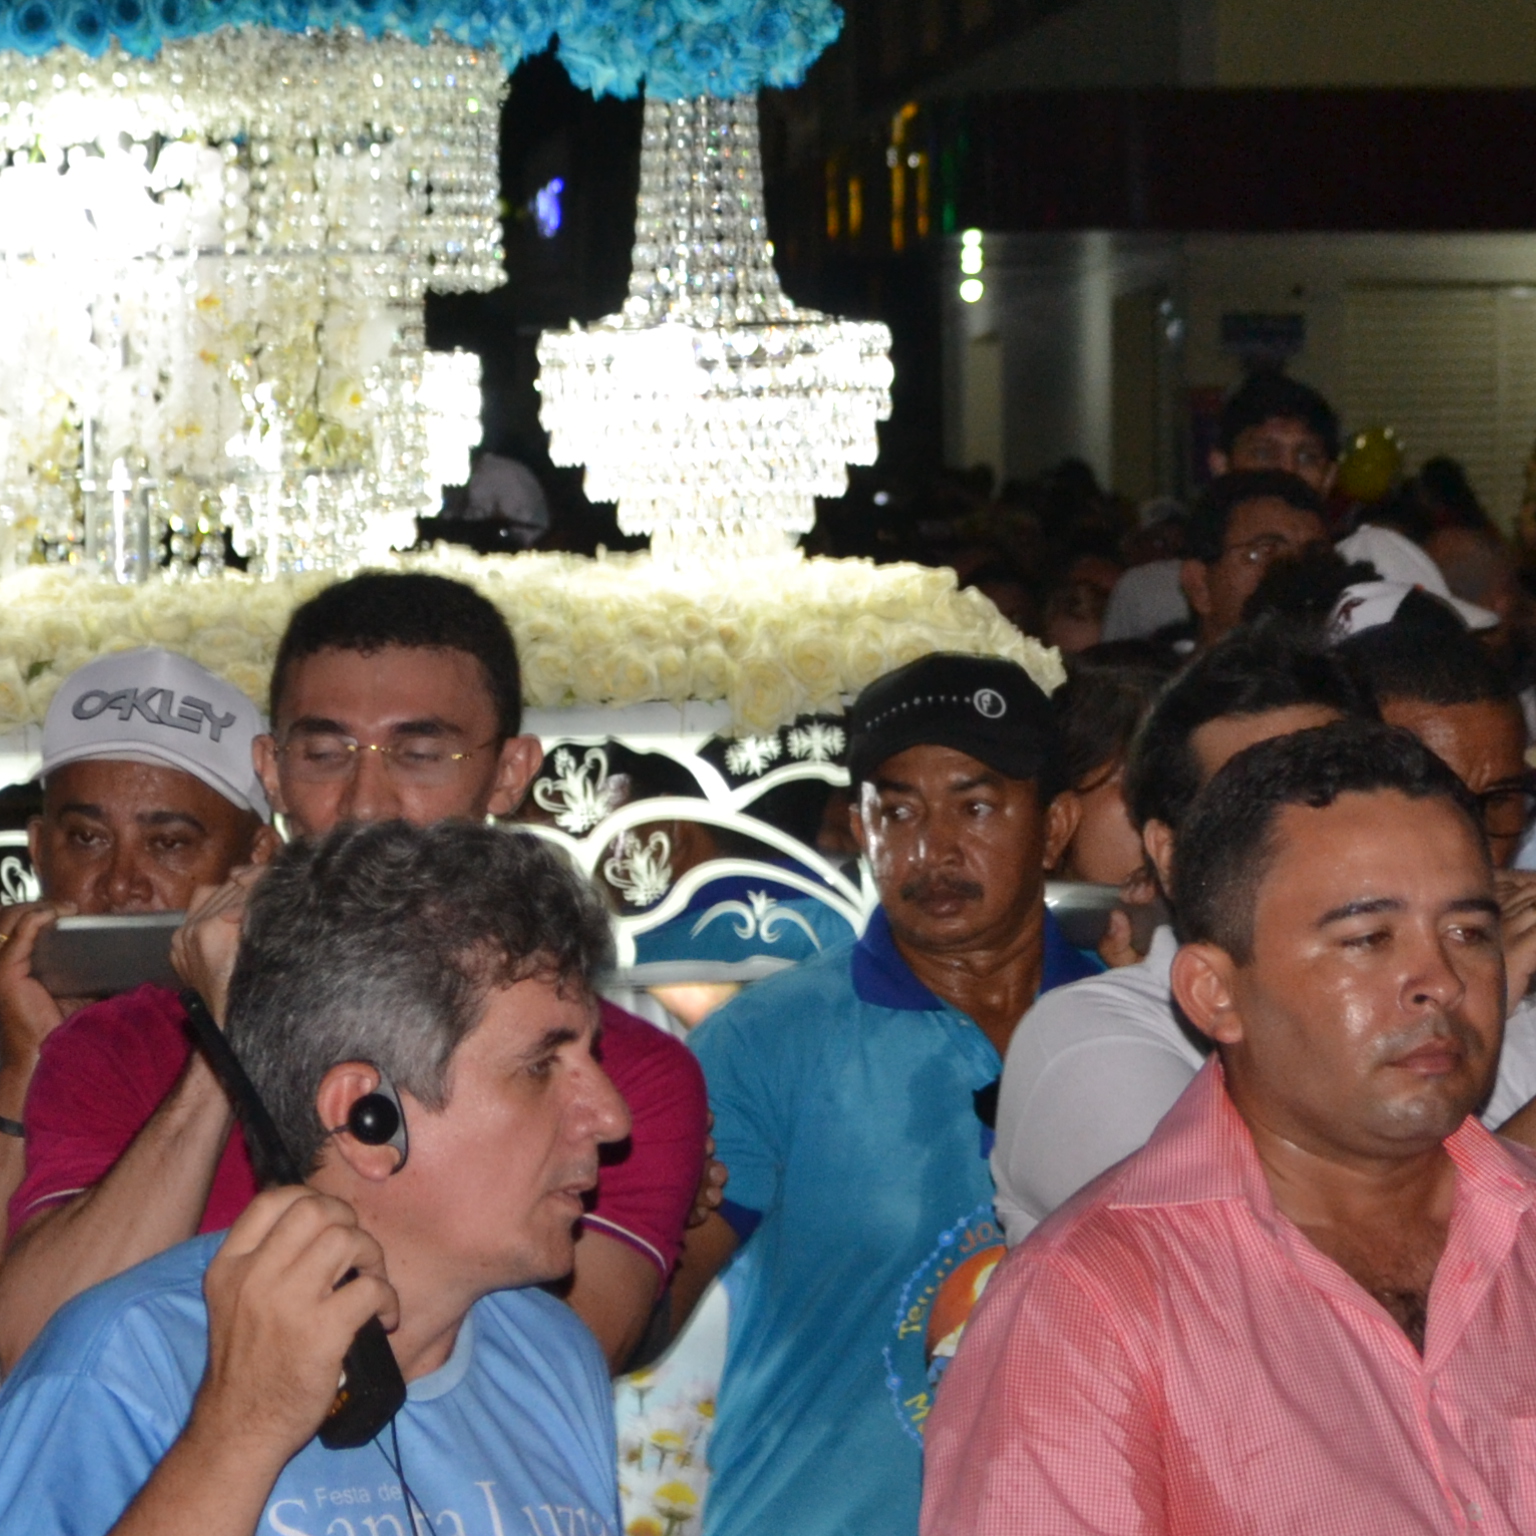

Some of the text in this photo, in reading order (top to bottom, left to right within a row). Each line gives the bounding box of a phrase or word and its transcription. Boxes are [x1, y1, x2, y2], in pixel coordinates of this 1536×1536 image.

[72, 686, 237, 743] OAKLEY
[314, 1482, 404, 1509] Festa de
